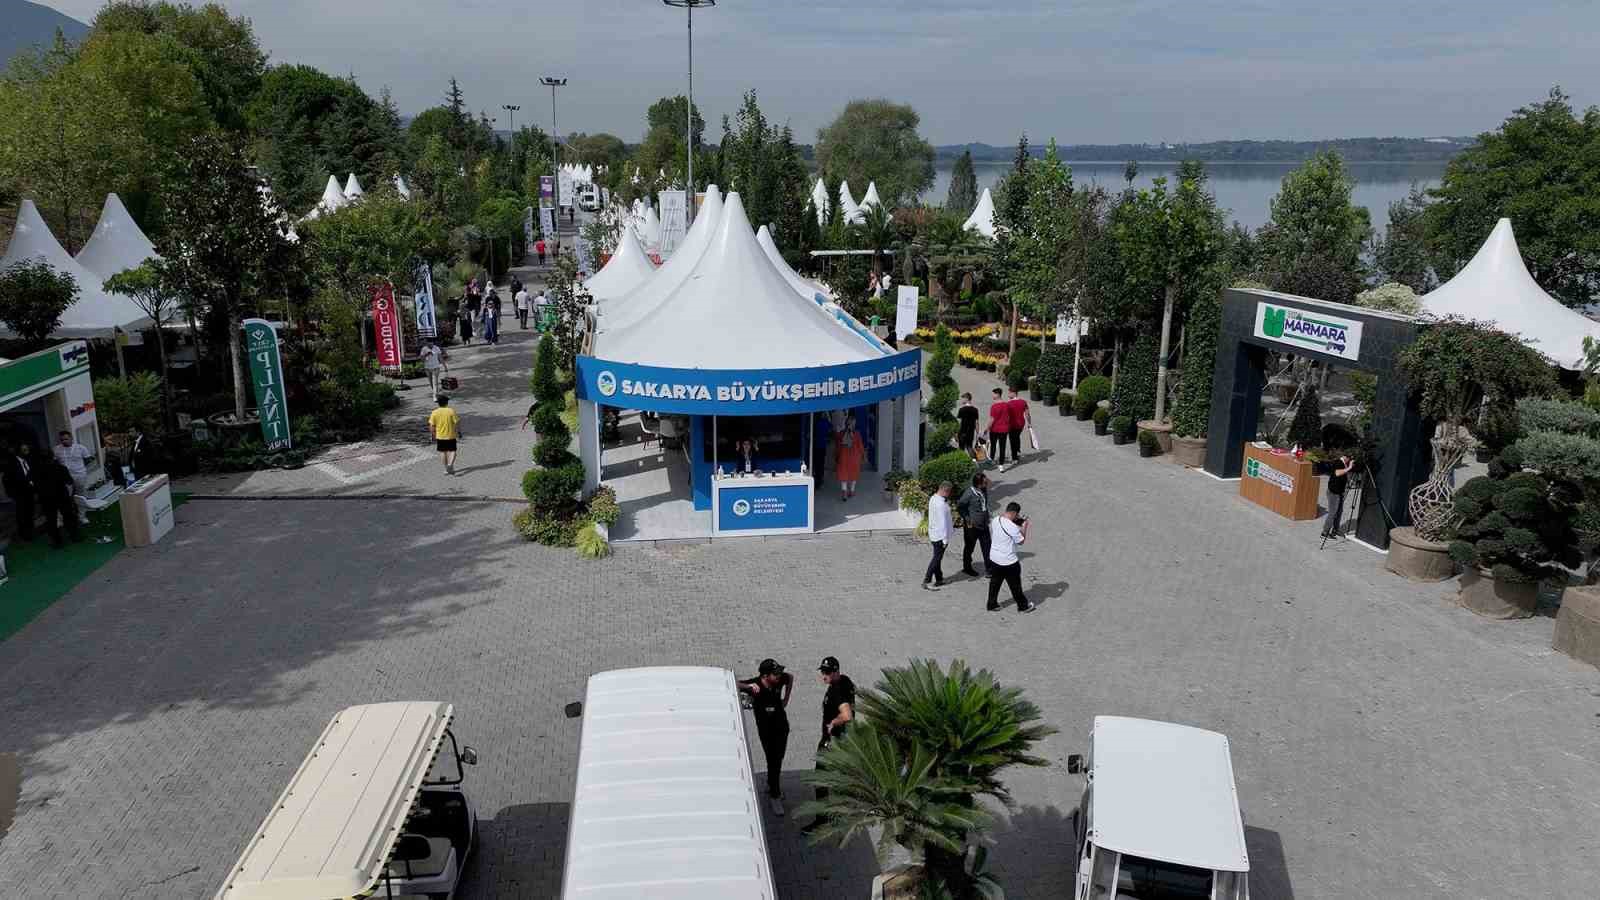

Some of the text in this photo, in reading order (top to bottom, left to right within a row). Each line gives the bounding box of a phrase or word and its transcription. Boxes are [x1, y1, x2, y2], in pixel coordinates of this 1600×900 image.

[1284, 318, 1346, 343] MARMARA
[621, 361, 918, 402] SAKARYA BÜYÜKŞEHİR BELEDİYESİ
